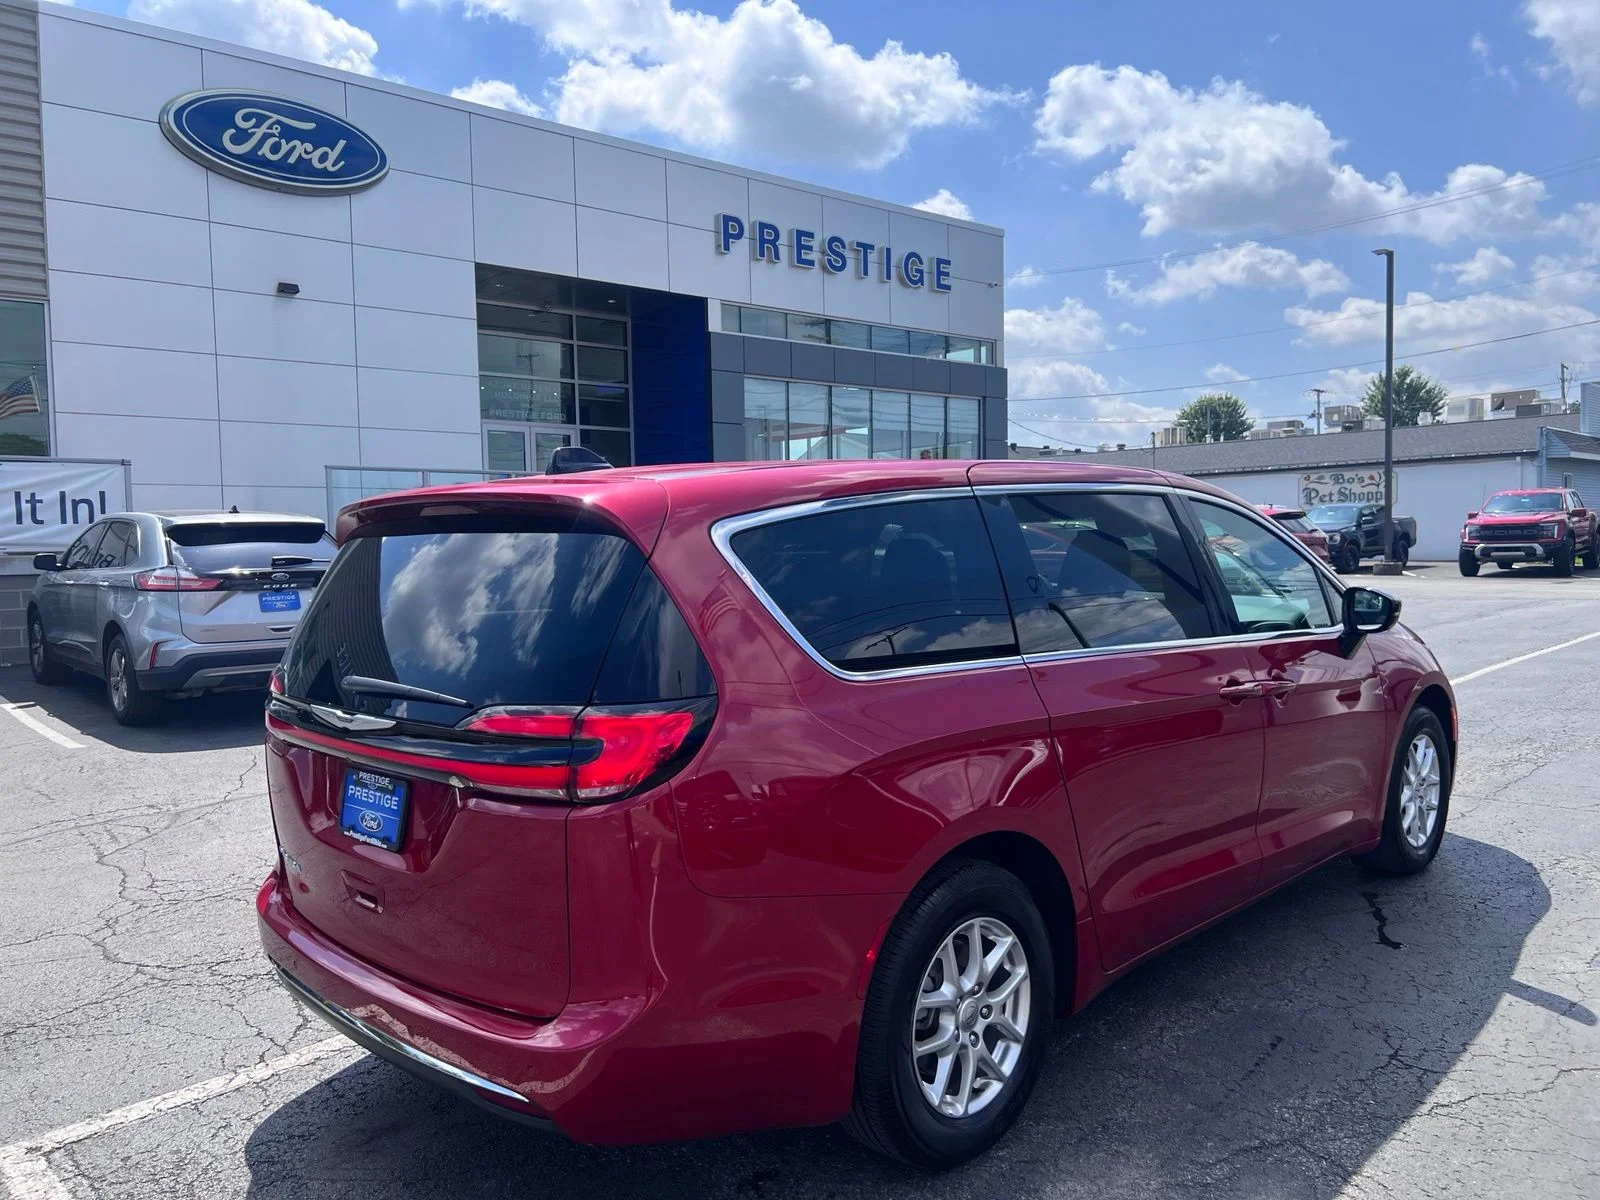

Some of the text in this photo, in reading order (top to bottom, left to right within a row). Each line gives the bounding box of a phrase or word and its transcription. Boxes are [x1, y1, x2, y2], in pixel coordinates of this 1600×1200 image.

[222, 108, 347, 172] Ford
[715, 212, 952, 293] PRESTIGE
[1330, 473, 1365, 485] Bo's
[1302, 487, 1385, 506] Pet Shopp
[14, 491, 45, 525] It
[359, 772, 390, 785] PRESTIGE
[348, 785, 399, 809] PRESTIGE
[362, 812, 379, 829] Ford
